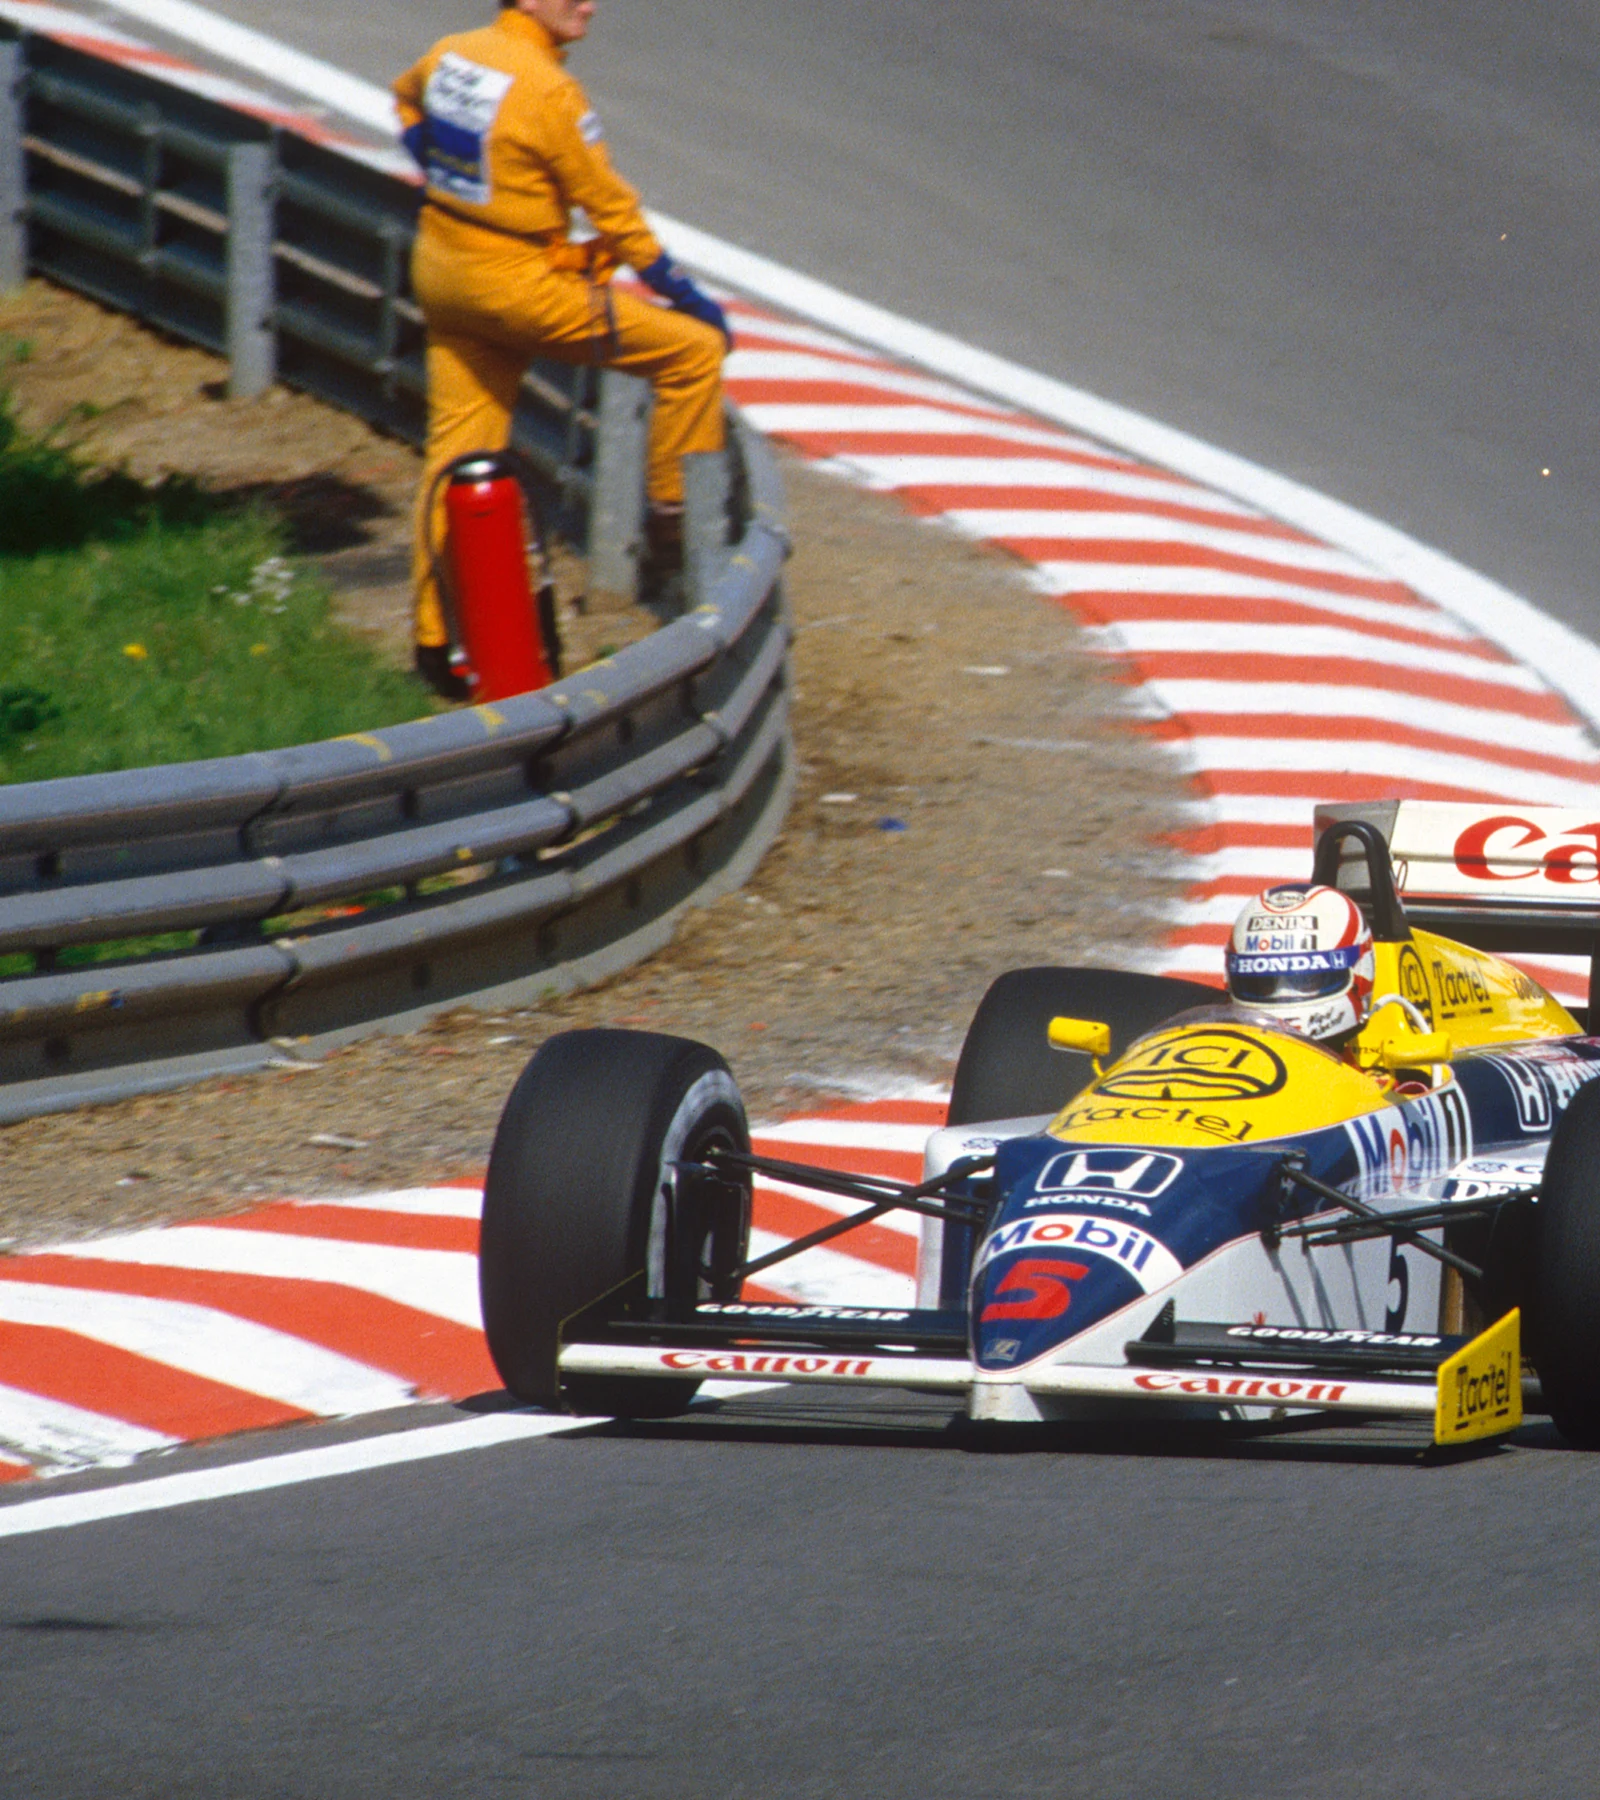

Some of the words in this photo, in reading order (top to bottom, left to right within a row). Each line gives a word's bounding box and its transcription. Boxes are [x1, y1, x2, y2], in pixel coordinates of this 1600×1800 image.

[1251, 915, 1314, 931] DENIM
[1246, 934, 1295, 951] Mobil
[1238, 955, 1331, 973] HONDA
[1431, 957, 1491, 1006] Tactel
[1149, 1046, 1252, 1069] ICI
[1023, 1193, 1153, 1218] HONDA
[983, 1220, 1156, 1273] Mobil
[980, 1259, 1091, 1323] 5
[694, 1303, 911, 1322] GOODYEAR
[1226, 1326, 1442, 1348] GOODYEAR
[659, 1352, 874, 1377] Canon
[1133, 1374, 1348, 1402] Canon
[1455, 1350, 1512, 1420] Tactel
